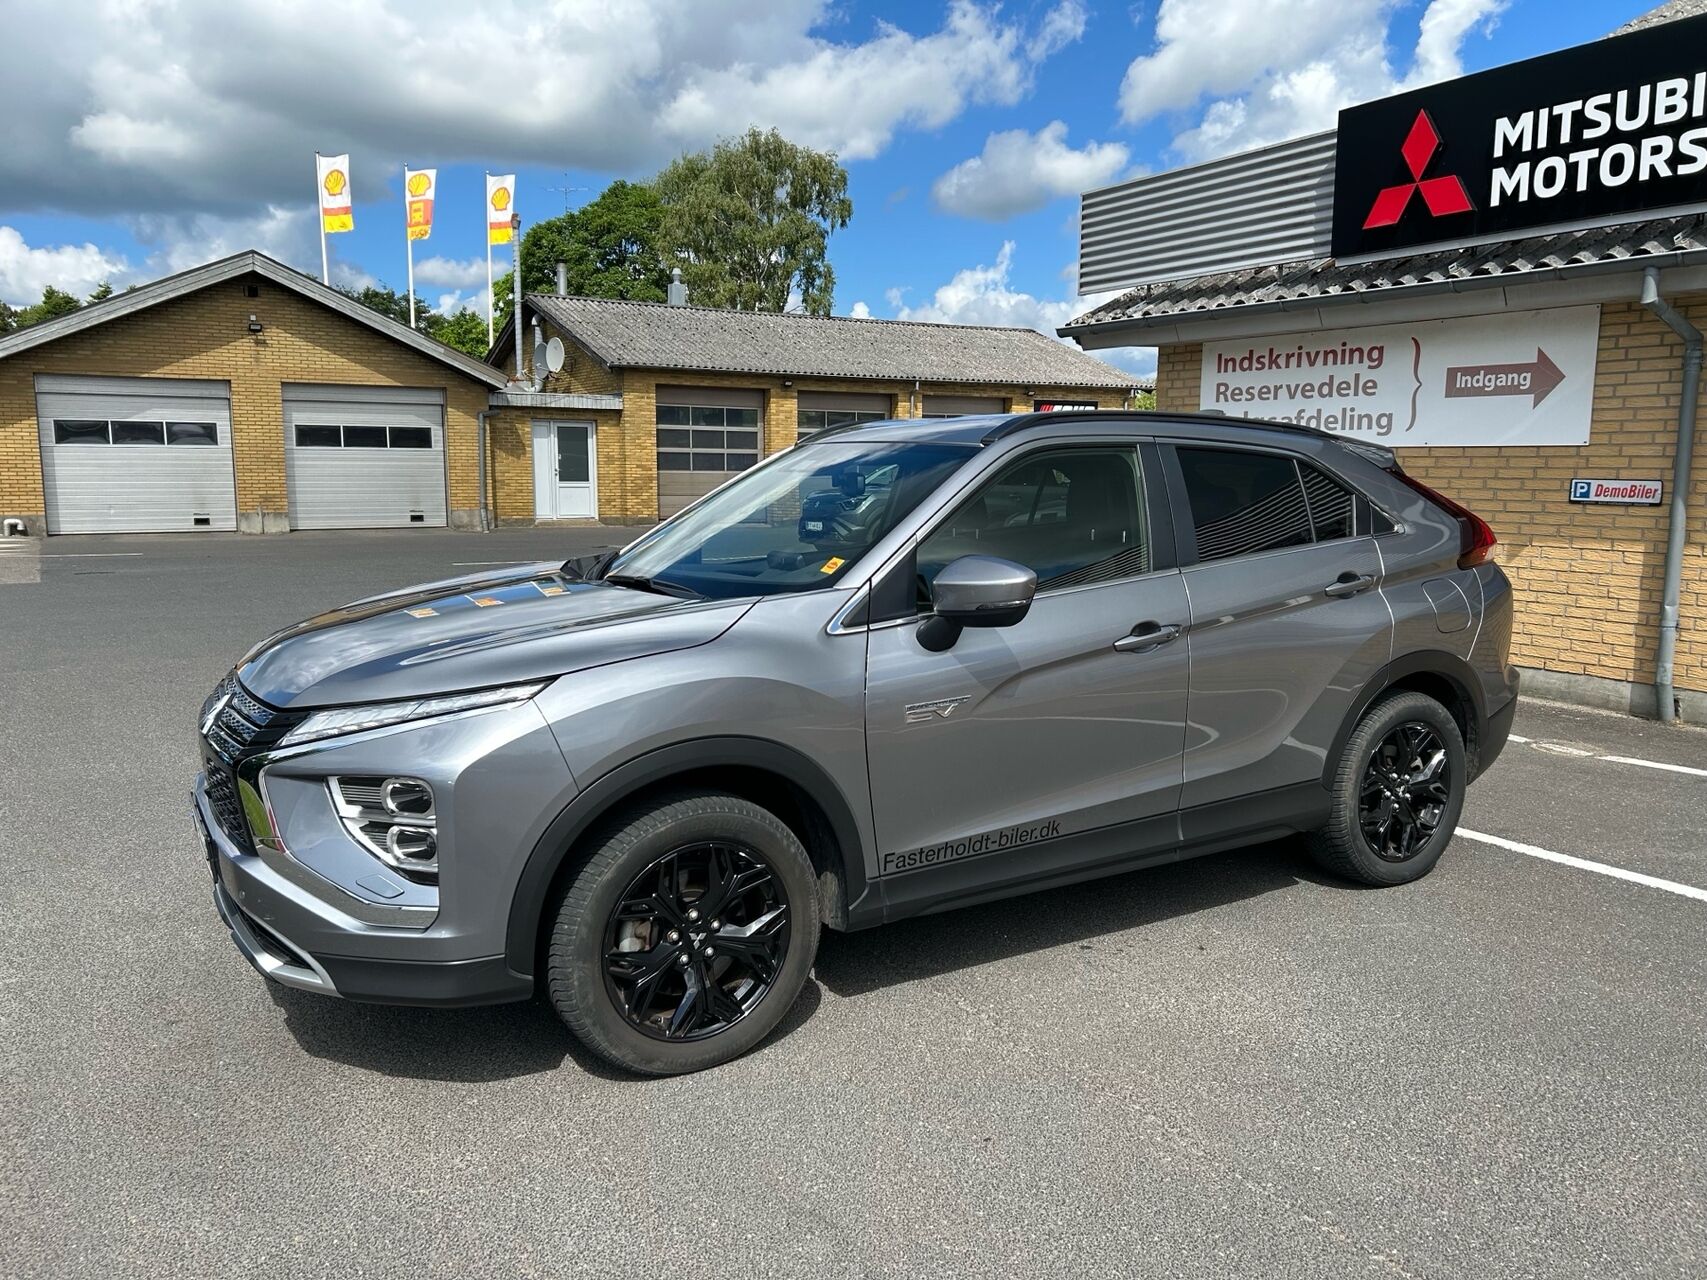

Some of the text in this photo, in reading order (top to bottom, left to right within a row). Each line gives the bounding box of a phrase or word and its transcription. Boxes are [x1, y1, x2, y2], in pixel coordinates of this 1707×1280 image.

[1493, 71, 1707, 158] MITSUBI
[1490, 127, 1707, 207] MOTORS
[1216, 341, 1385, 374] Indskrivning
[1215, 373, 1378, 403] Reservedele
[1455, 370, 1532, 391] Indgang
[1575, 482, 1659, 499] P DemoBiler
[883, 820, 1061, 872] Fasterholdt-biler.dk
